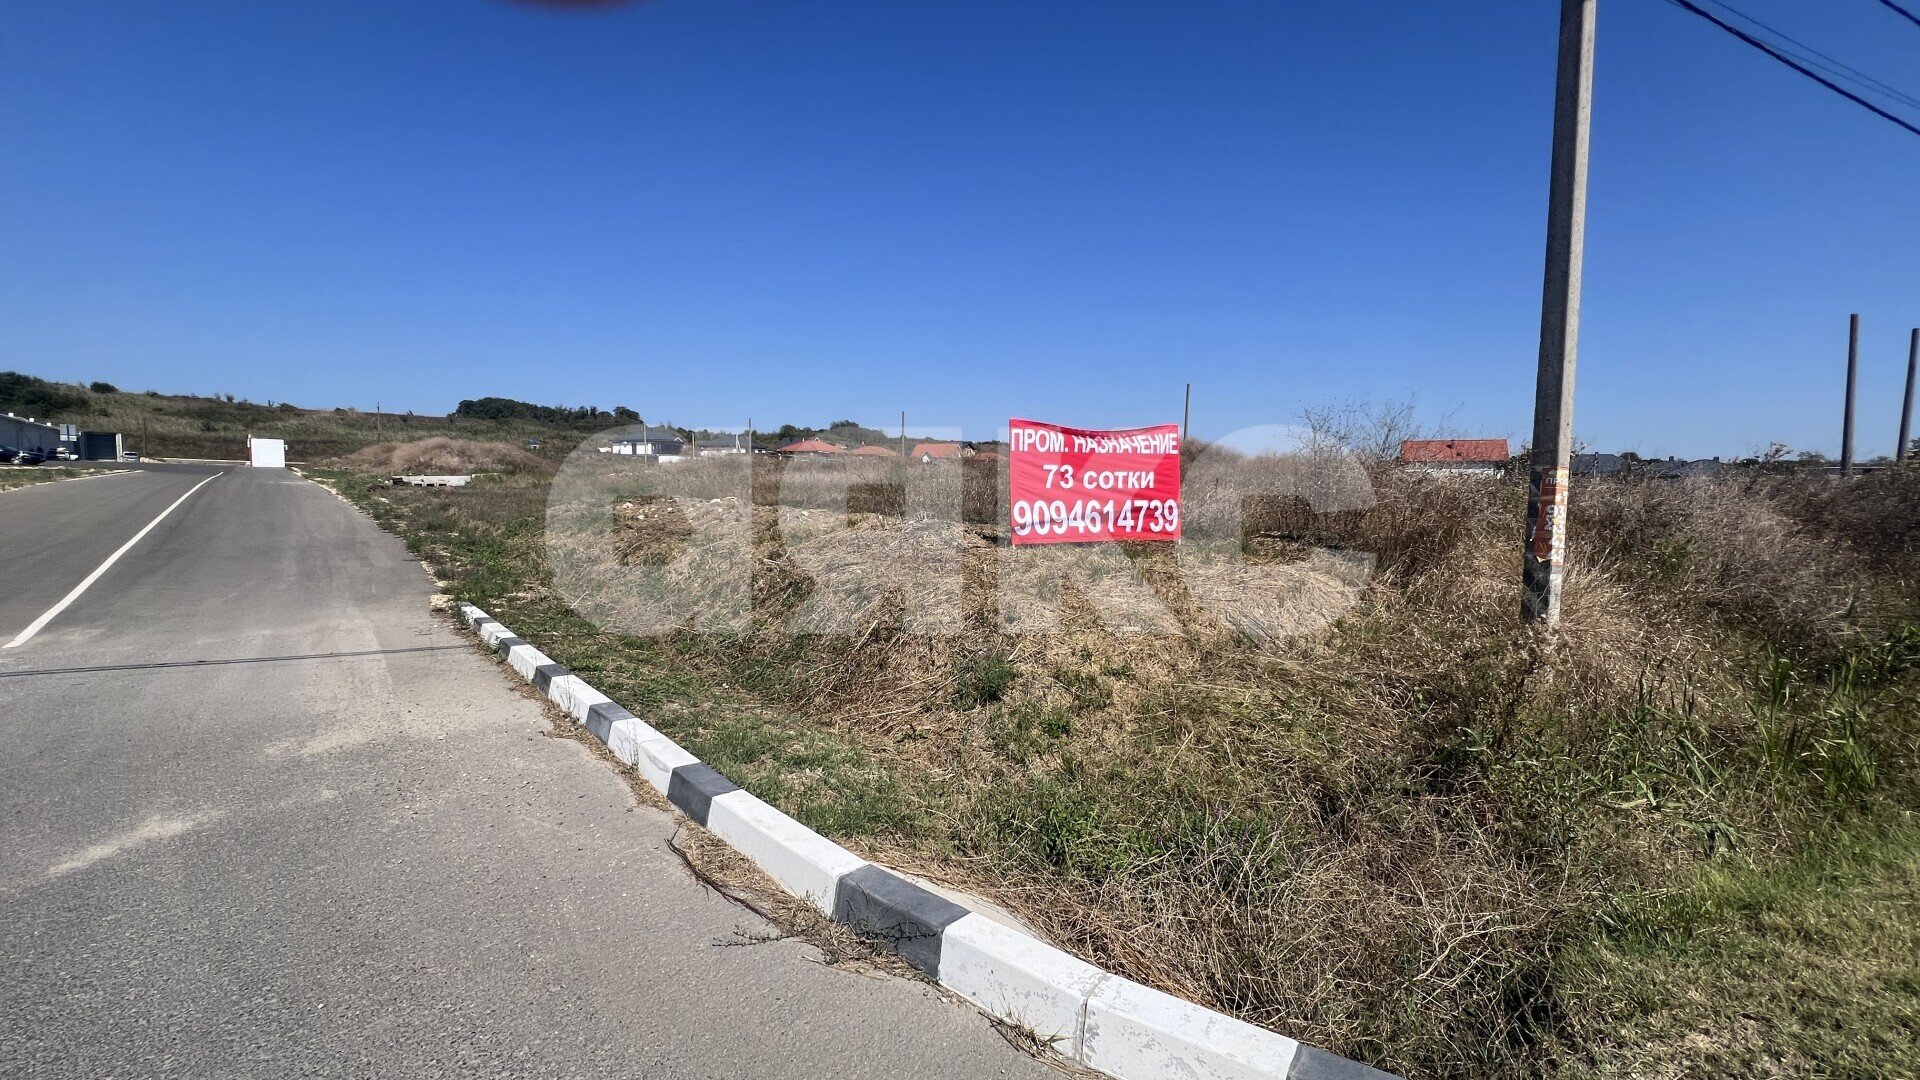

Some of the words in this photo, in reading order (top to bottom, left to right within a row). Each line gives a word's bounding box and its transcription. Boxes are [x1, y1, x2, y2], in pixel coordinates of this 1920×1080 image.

[1011, 428, 1069, 453] ПРОМ.
[1072, 433, 1179, 455] НАЗНАЧЕНИЕ
[1042, 464, 1074, 489] 73
[1013, 499, 1179, 536] 9094614739
